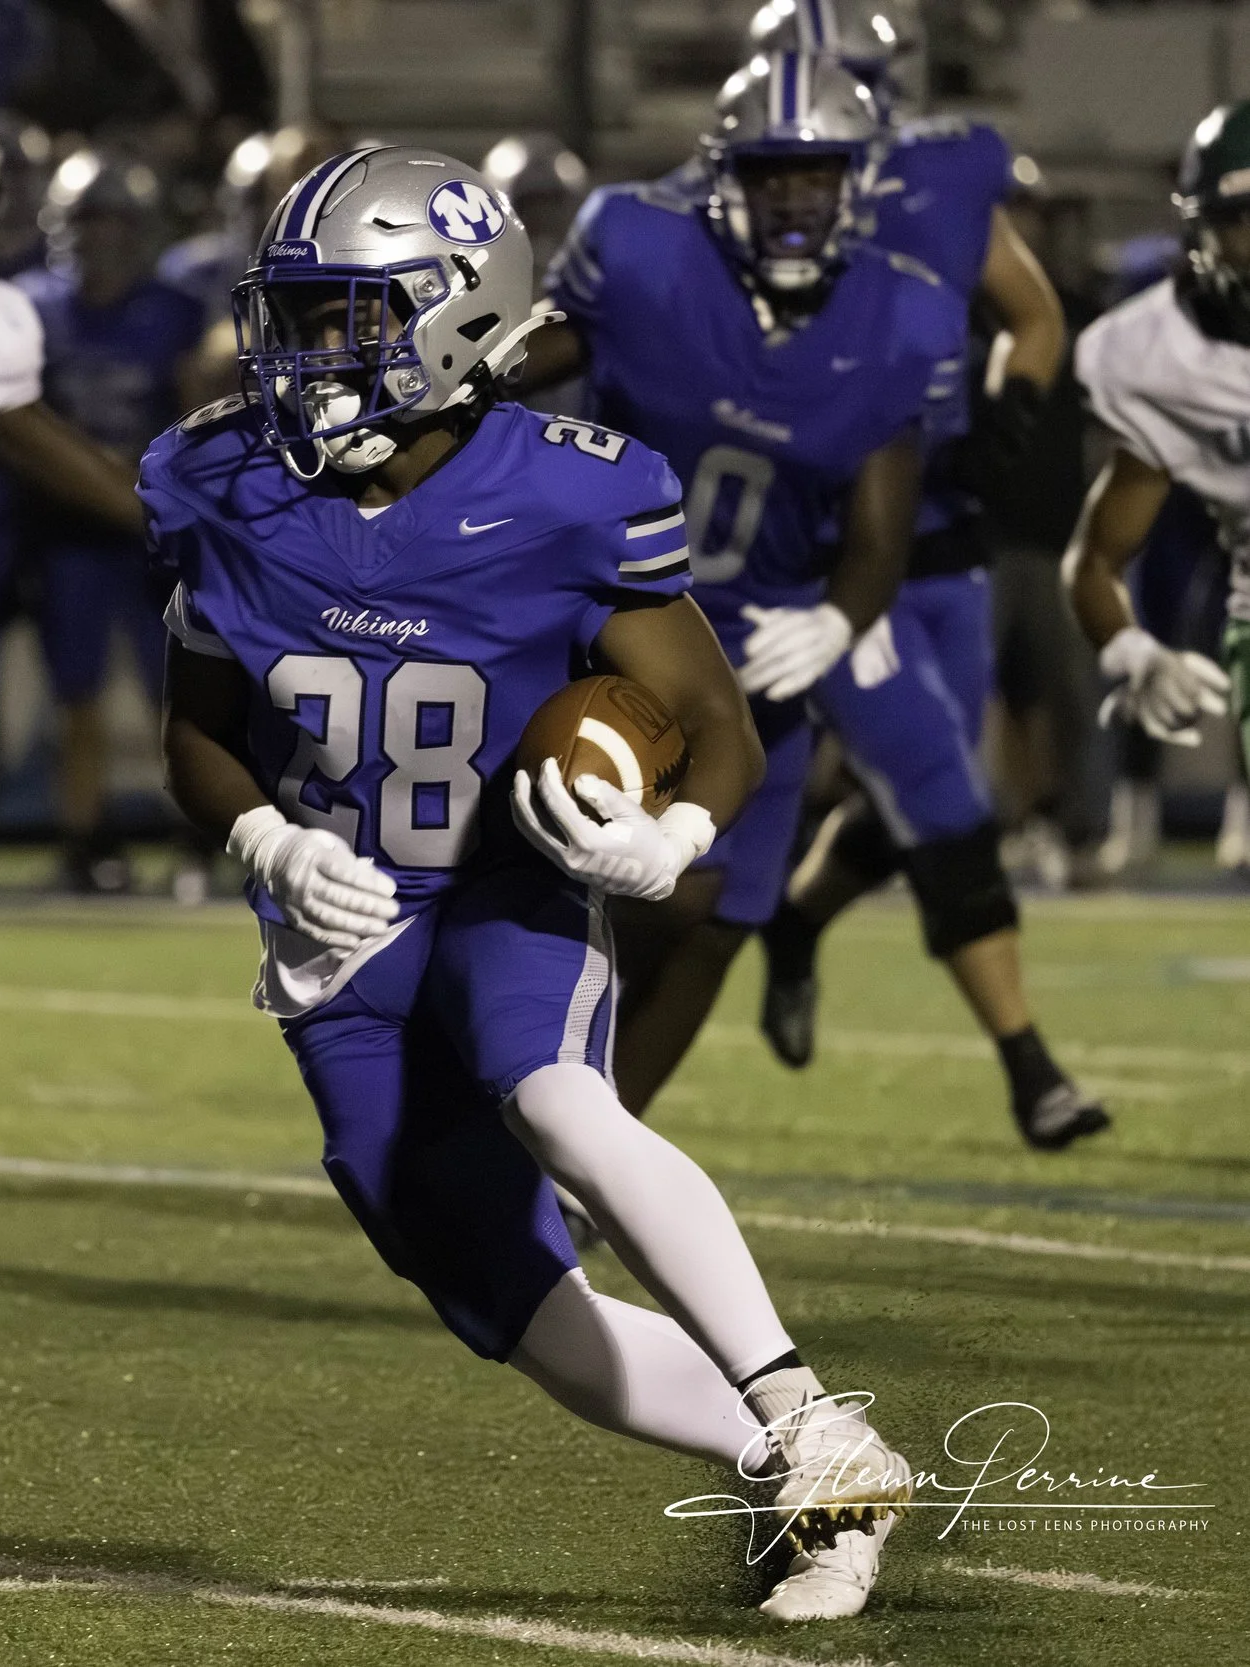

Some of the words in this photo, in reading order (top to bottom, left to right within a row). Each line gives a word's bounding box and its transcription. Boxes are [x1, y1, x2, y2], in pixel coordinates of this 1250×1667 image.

[431, 182, 504, 241] M
[267, 243, 309, 260] Vikings
[543, 414, 627, 463] 2
[685, 445, 775, 584] 0
[321, 606, 430, 645] Vikings
[266, 653, 488, 868] 28
